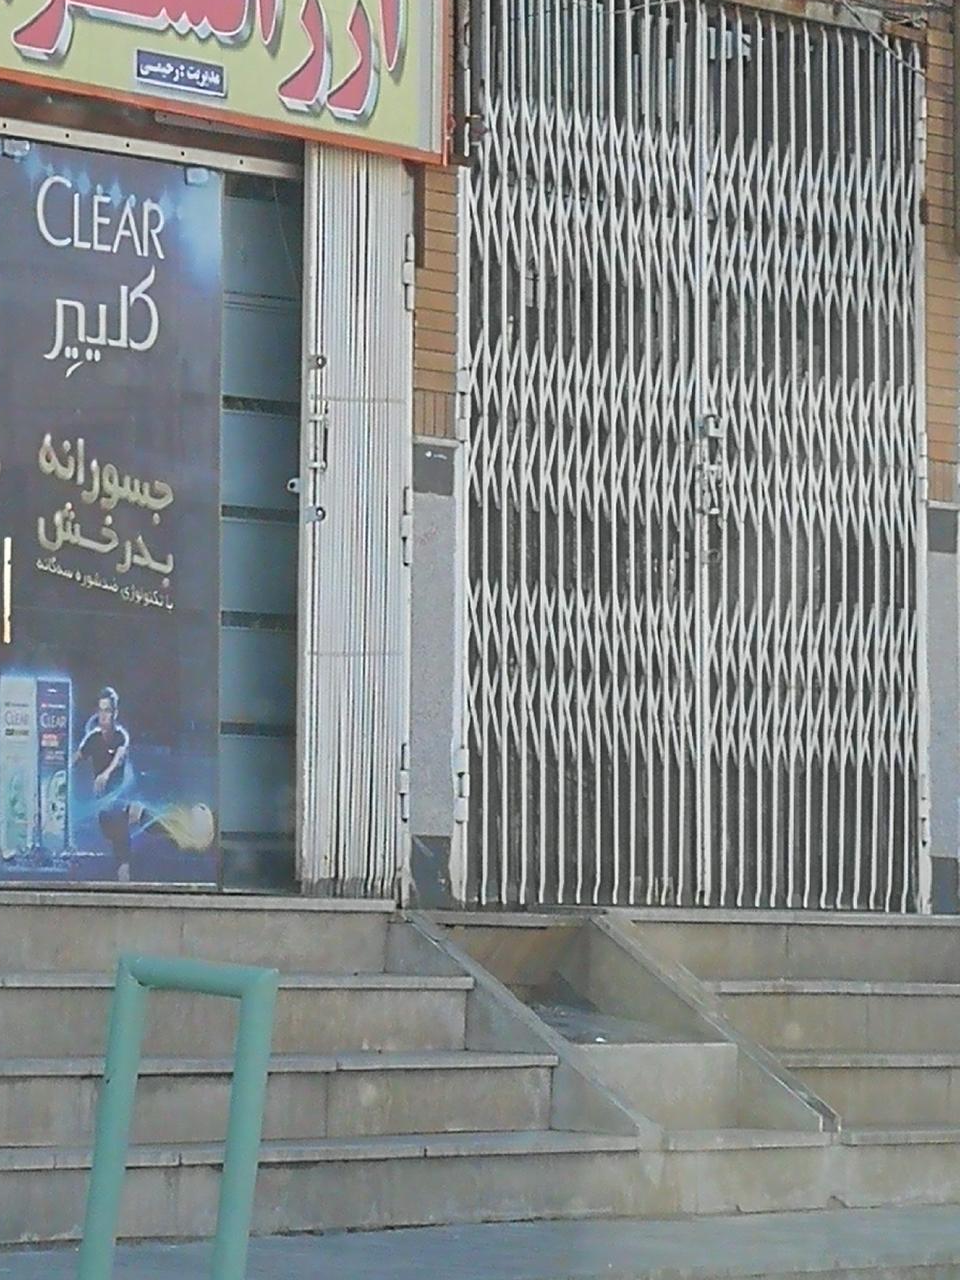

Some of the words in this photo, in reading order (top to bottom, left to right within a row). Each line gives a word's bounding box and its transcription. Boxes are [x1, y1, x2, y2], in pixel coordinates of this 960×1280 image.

[36, 175, 165, 260] CLEAR
[38, 432, 174, 526] جسورانه
[37, 502, 174, 586] بدرخش
